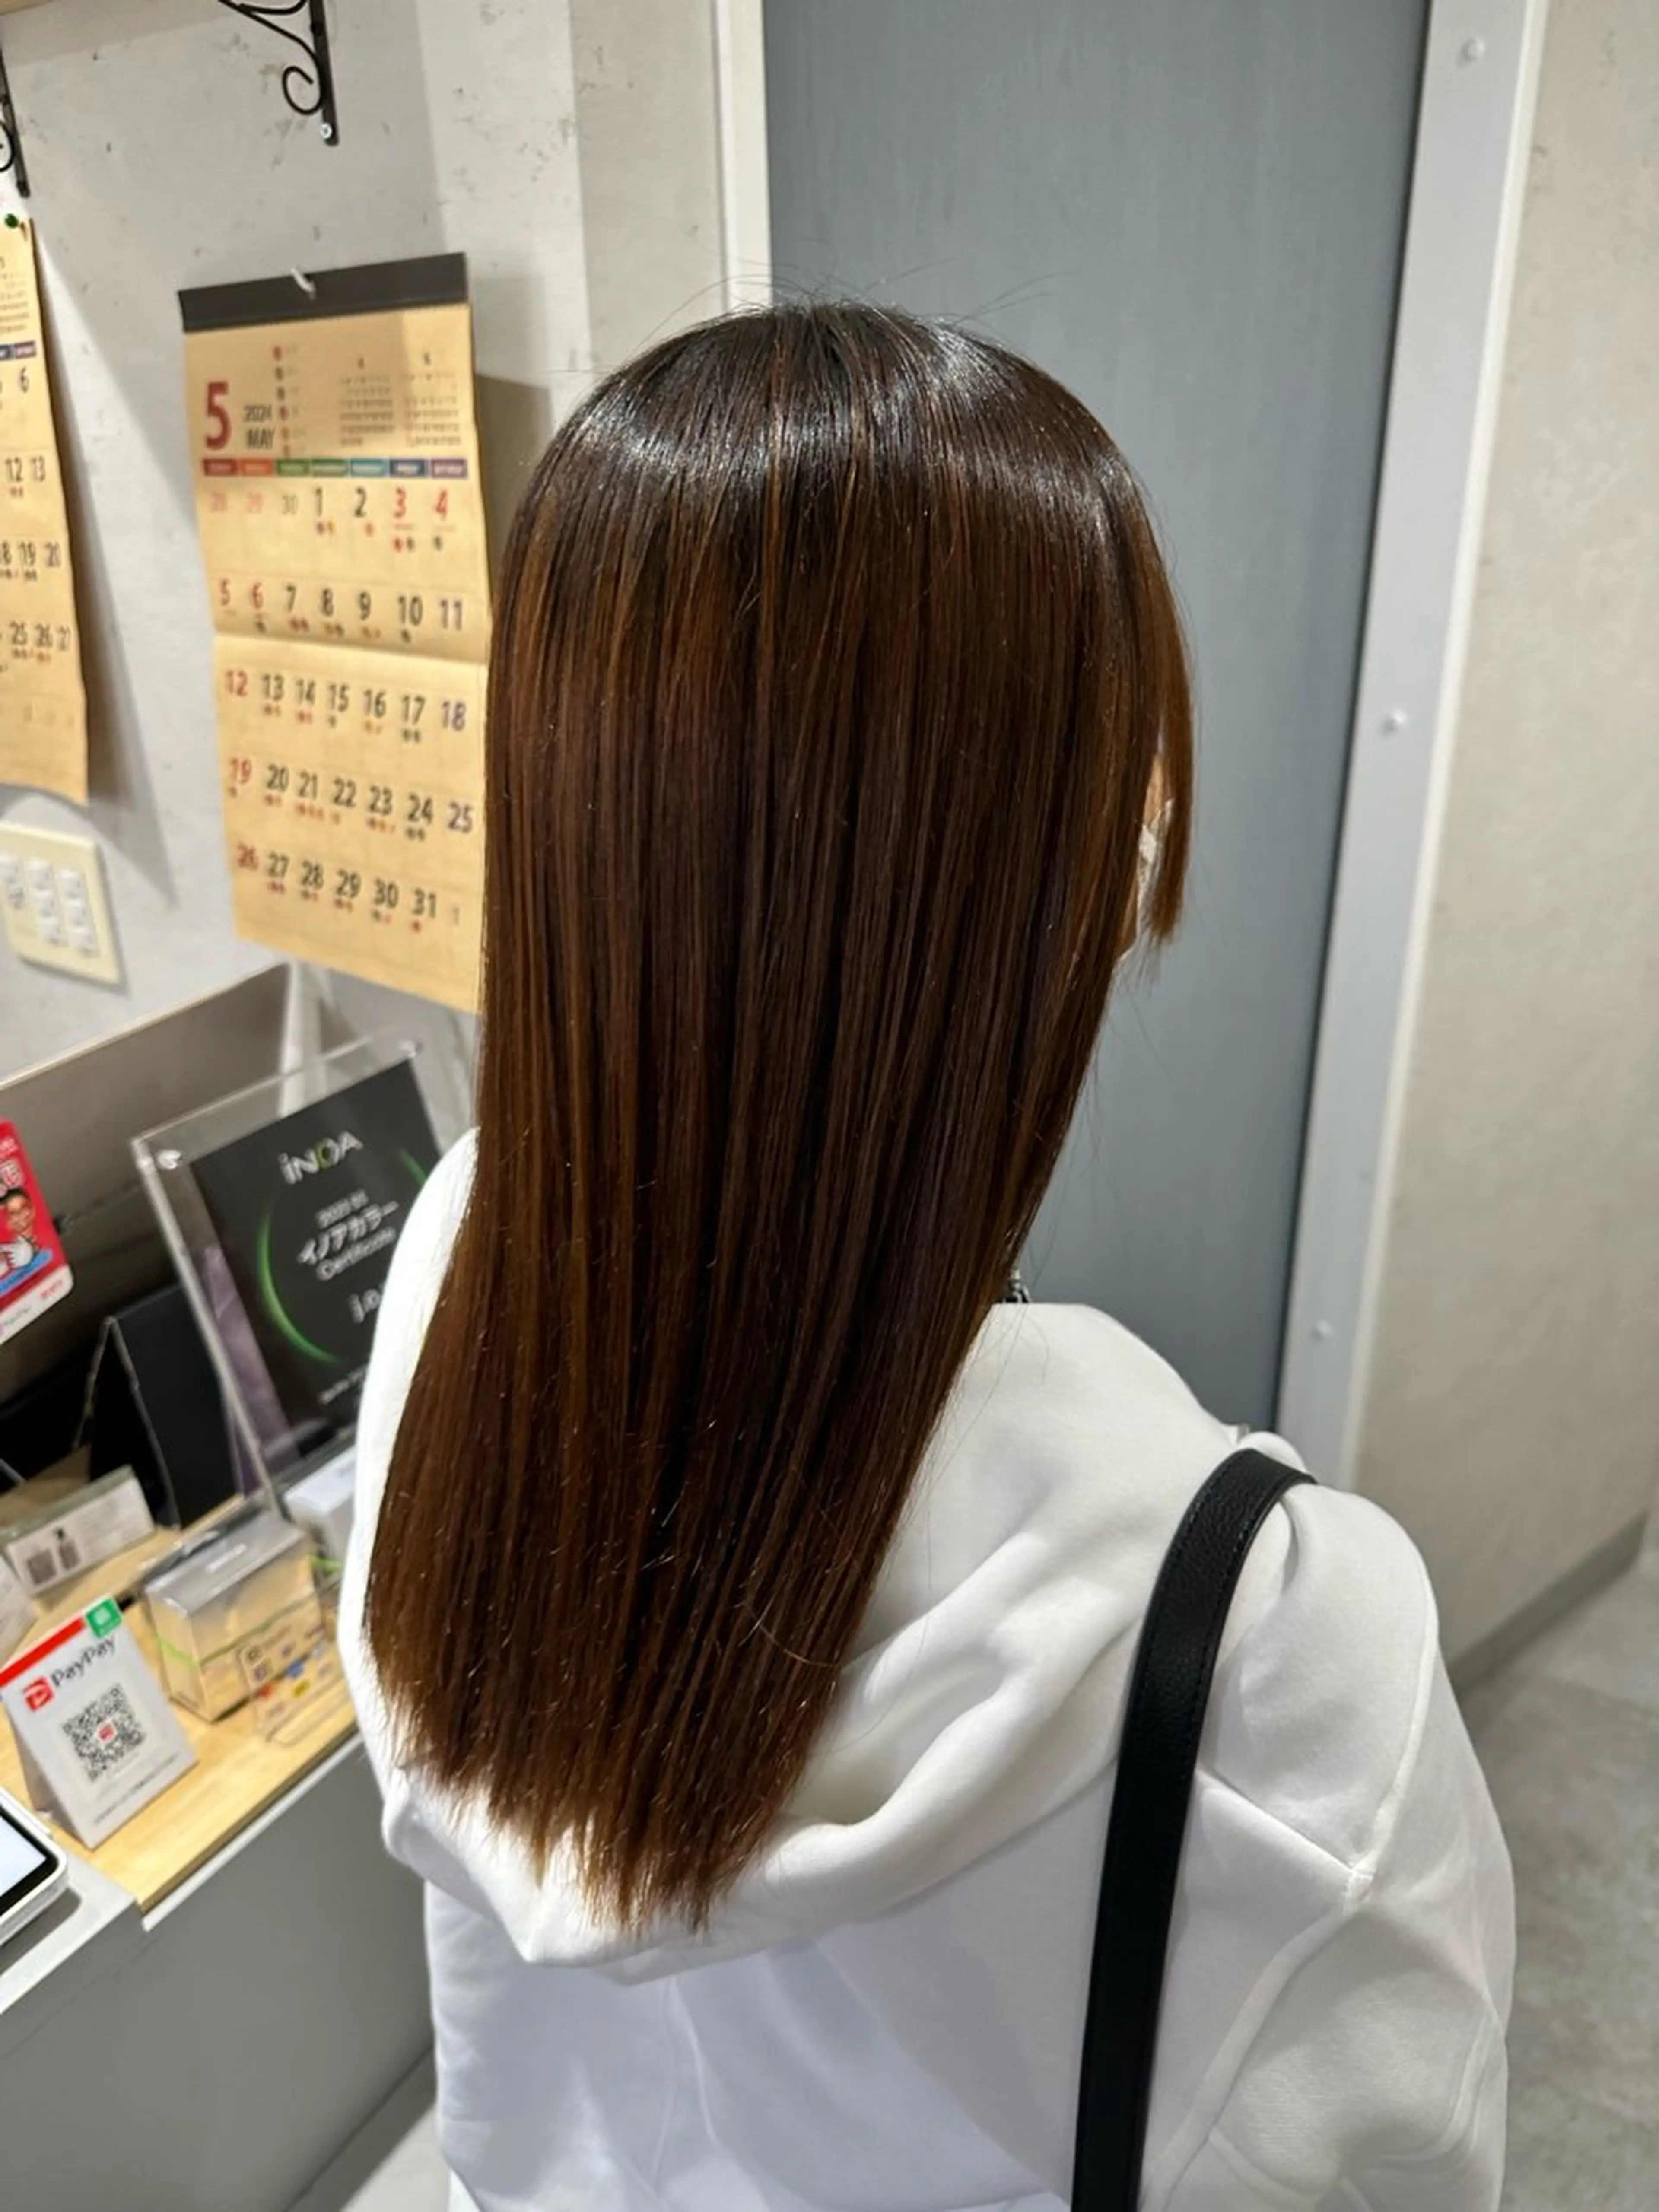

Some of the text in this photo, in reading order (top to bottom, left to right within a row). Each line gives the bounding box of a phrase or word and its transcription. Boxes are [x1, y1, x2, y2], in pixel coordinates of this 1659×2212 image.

[18, 368, 29, 392] 6
[206, 381, 232, 450] 5
[243, 404, 272, 422] 2024
[246, 427, 275, 450] MAY
[5, 455, 45, 483] 12 13
[314, 486, 323, 517] 1
[354, 487, 367, 518] 2
[394, 487, 407, 518] 3
[435, 489, 448, 521] 4
[219, 578, 463, 631] 5 6 7 8 9 10 11
[225, 670, 467, 731] 12 13 14 15 16 17 18
[229, 758, 473, 833] 19 20 21 22 23 24 25
[267, 851, 290, 879] 27
[300, 861, 324, 889] 28
[335, 869, 361, 899] 29
[374, 878, 398, 909] 30
[413, 888, 436, 919] 31
[51, 1634, 115, 1687] PayPay
